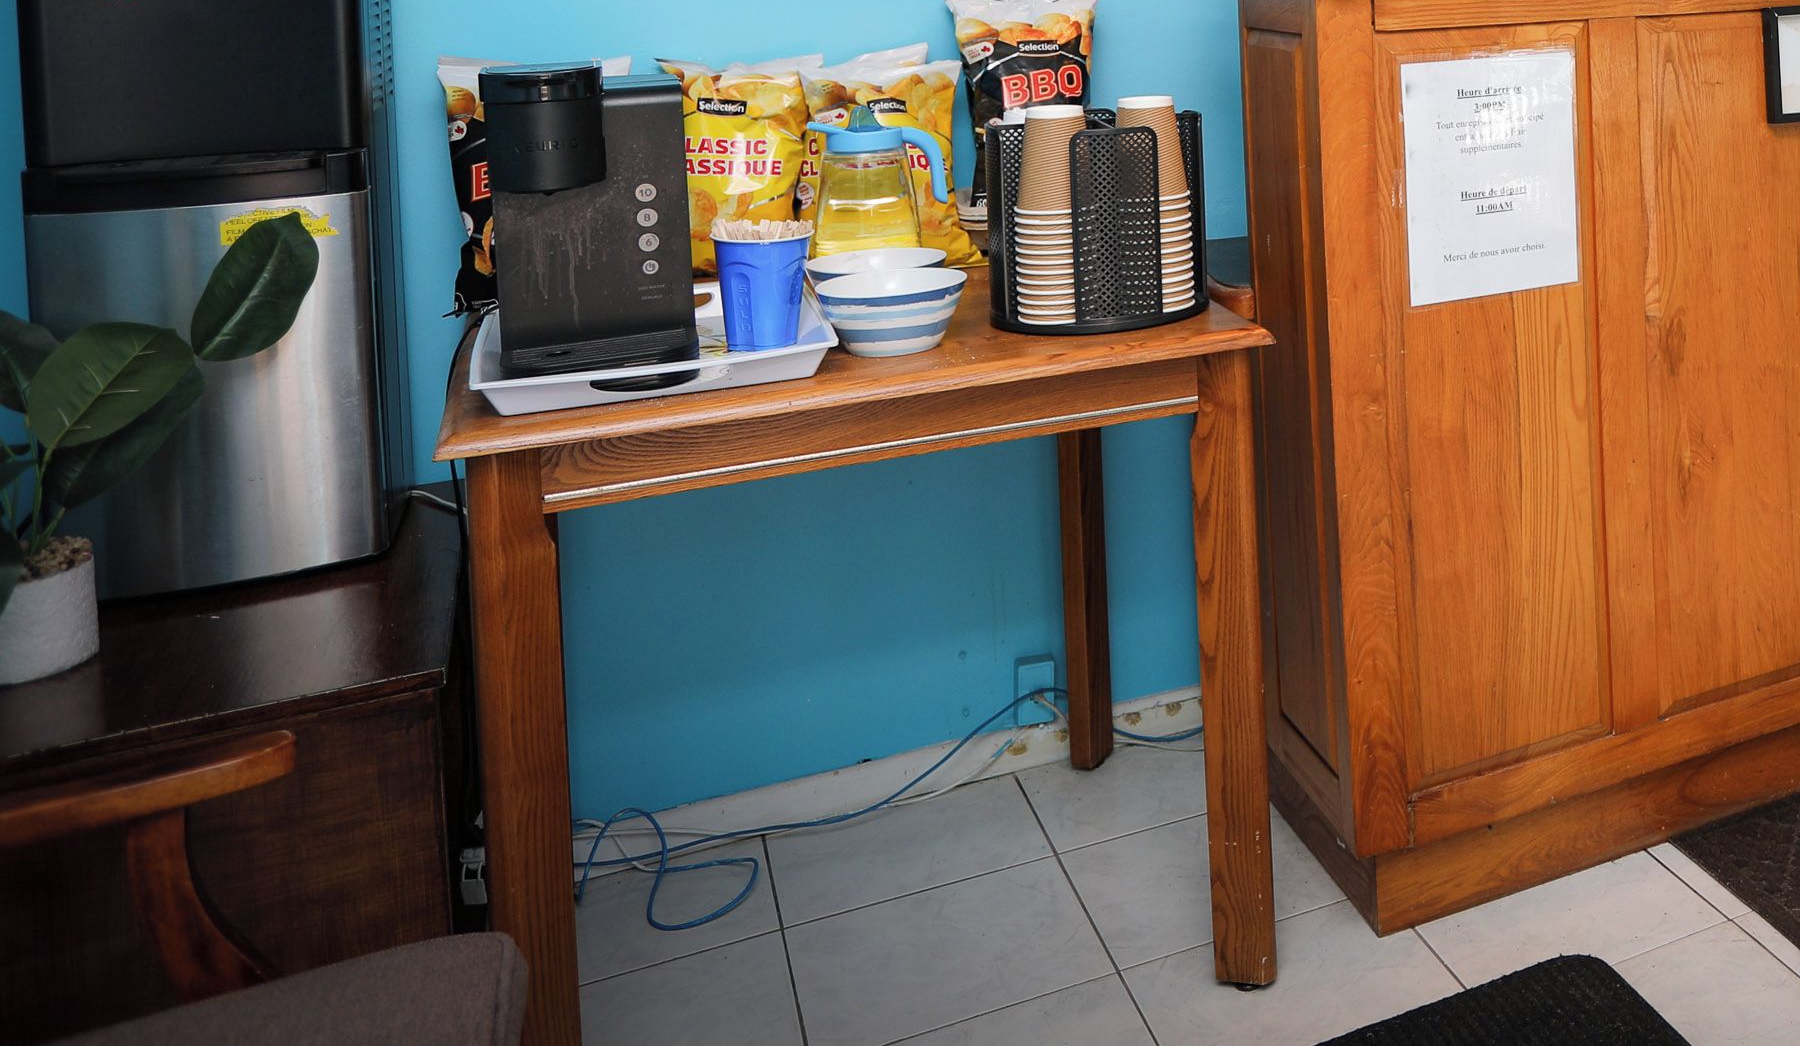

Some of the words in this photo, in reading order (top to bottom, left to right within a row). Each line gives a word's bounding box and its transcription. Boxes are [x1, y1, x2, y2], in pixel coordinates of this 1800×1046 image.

[1018, 43, 1060, 52] Selection
[1001, 64, 1083, 110] BBQ
[1457, 88, 1483, 98] Heure
[698, 99, 746, 114] Selection
[868, 101, 906, 112] Selection
[1436, 121, 1454, 130] Tout
[685, 137, 768, 155] LASSIC
[686, 158, 782, 176] ASSIQUE
[639, 188, 652, 197] 10
[1460, 190, 1486, 200] Heure
[1488, 187, 1498, 197] de
[1500, 184, 1527, 196] départ
[1475, 201, 1514, 214] 11:00AM
[1443, 252, 1467, 263] Merci
[1469, 250, 1479, 259] de
[1480, 249, 1499, 258] nous
[1500, 244, 1521, 255] avoir
